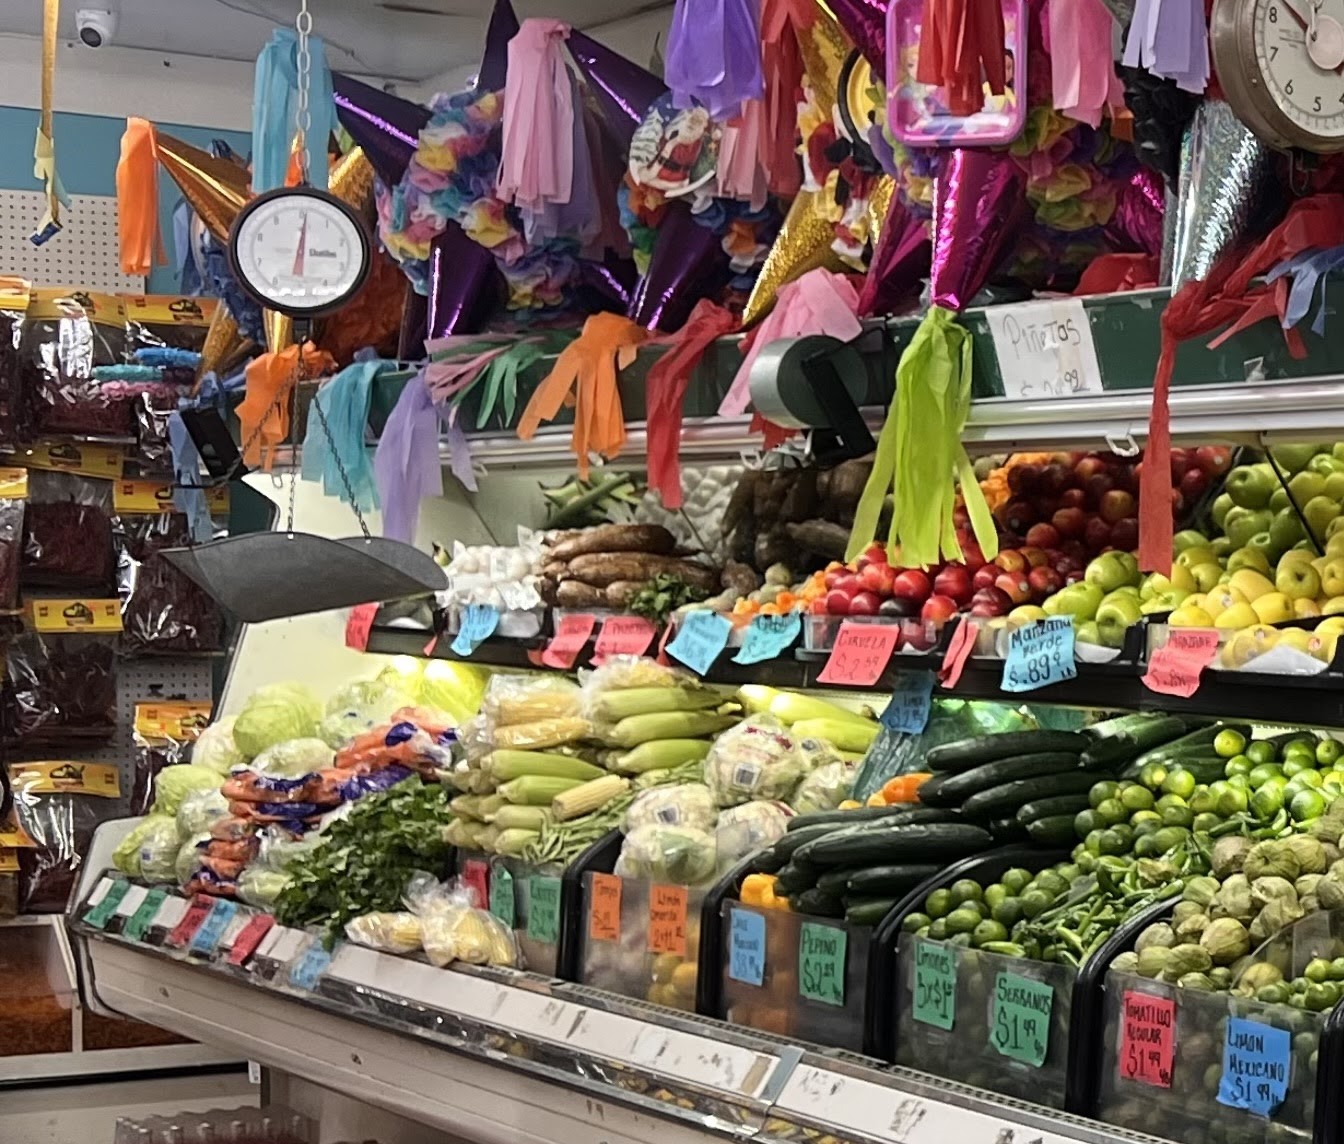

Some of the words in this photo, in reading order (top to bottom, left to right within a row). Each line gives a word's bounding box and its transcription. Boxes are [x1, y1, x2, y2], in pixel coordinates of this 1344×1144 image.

[1269, 6, 1278, 23] 8
[1270, 47, 1278, 62] 7
[1285, 79, 1294, 95] 6
[1313, 97, 1322, 112] 5
